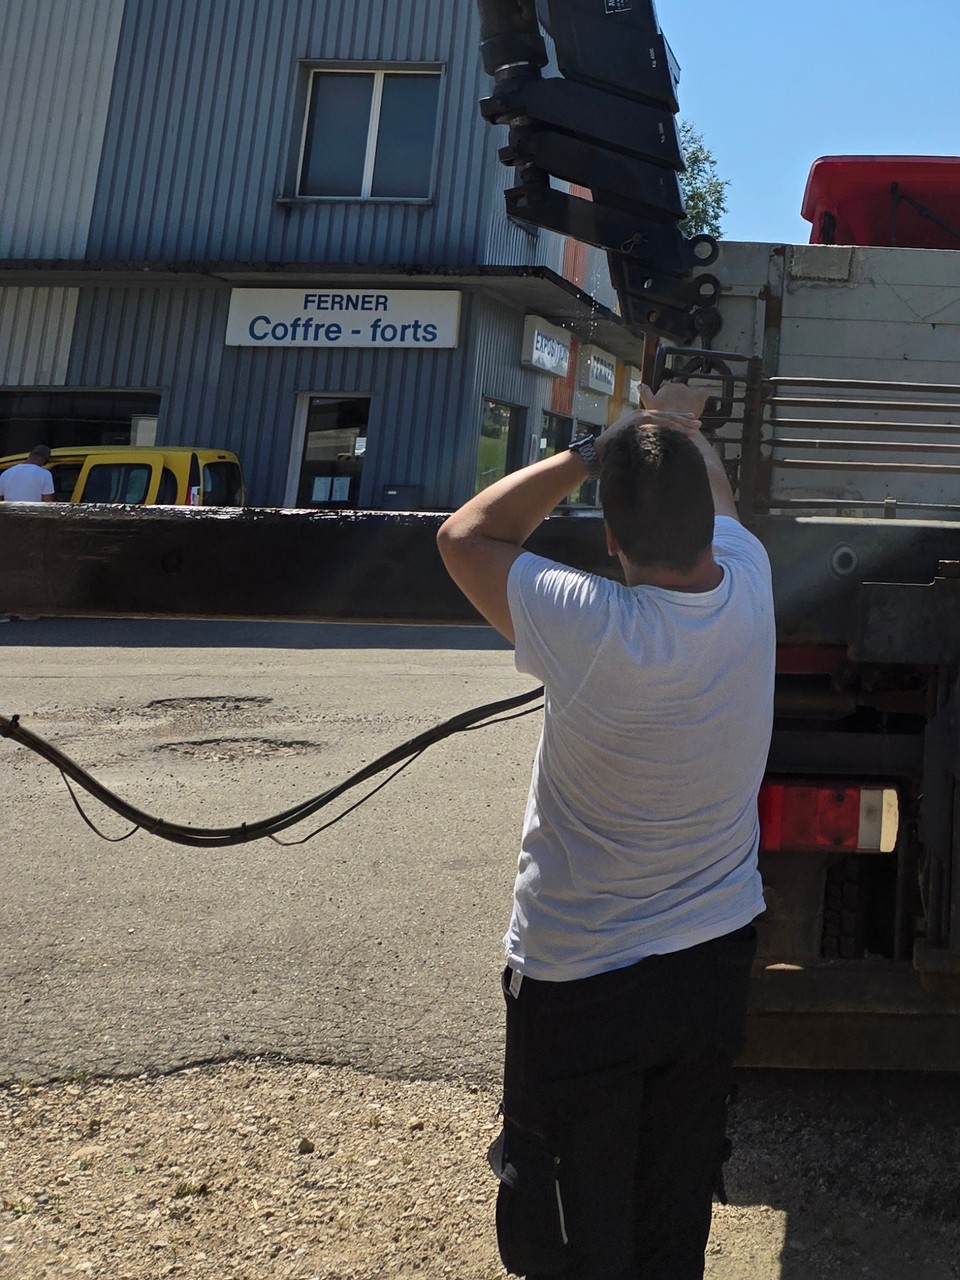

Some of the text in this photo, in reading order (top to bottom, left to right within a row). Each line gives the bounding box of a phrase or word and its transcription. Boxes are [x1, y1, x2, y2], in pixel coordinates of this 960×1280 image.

[303, 294, 388, 311] FERNER
[249, 315, 342, 341] Coffre
[370, 318, 438, 342] forts
